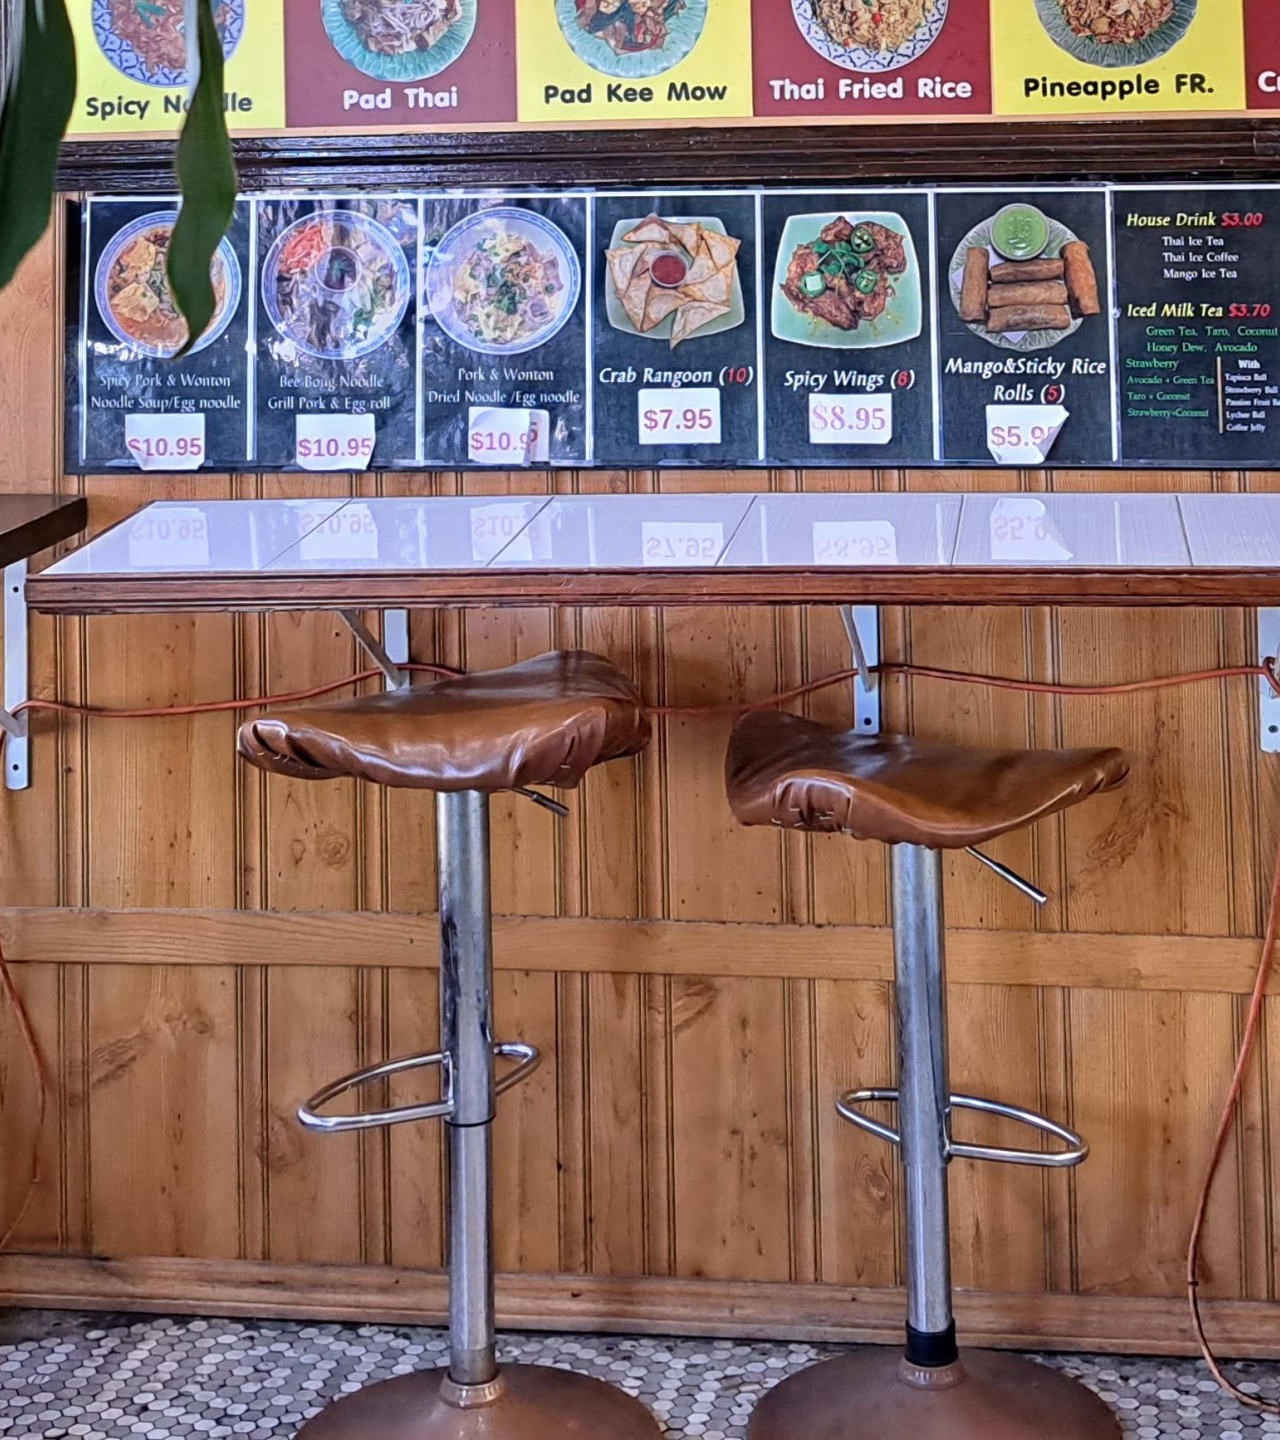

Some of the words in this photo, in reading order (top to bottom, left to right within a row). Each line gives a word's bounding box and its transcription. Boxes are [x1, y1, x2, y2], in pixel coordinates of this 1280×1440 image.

[545, 83, 592, 104] Pad
[608, 83, 653, 101] Kee
[667, 82, 727, 101] Mow
[770, 79, 824, 100] Thai
[838, 79, 903, 99] Fried
[918, 80, 972, 98] Rice
[1024, 74, 1159, 98] Pineapple
[1175, 73, 1213, 94] FR.
[86, 94, 150, 118] Spicy
[343, 87, 391, 110] Pad
[404, 86, 458, 108] Thai
[1127, 214, 1171, 226] House
[1176, 212, 1216, 226] Drink
[1221, 213, 1263, 226] $3.00
[1162, 237, 1184, 246] Thai
[1189, 237, 1202, 246] Ice
[1206, 237, 1224, 246] Tea
[1163, 253, 1184, 262] Thai
[1190, 253, 1203, 262] Ice
[1207, 252, 1238, 262] Coffee
[1163, 269, 1197, 280] Mango
[1202, 269, 1216, 278] Ice
[1220, 269, 1237, 278] Tea
[1128, 303, 1156, 316] Iced
[1161, 304, 1194, 317] Milk
[1200, 304, 1223, 317] Tea
[458, 368, 485, 381] Pork
[490, 369, 498, 380] &
[504, 369, 553, 381] Wonton
[1072, 358, 1106, 374] Rice
[599, 367, 636, 383] Crab
[644, 368, 712, 388] Rangoon
[784, 370, 827, 391] Spicy
[834, 370, 884, 390] Wings
[429, 391, 460, 402] Dried
[465, 391, 506, 403] Noodle
[540, 391, 580, 403] noodle
[994, 385, 1033, 401] Rolls
[91, 396, 134, 409] Noodle
[199, 396, 241, 409] noodle
[644, 409, 712, 431] $7.95
[813, 405, 885, 431] $8.95
[298, 438, 372, 456] $10.95
